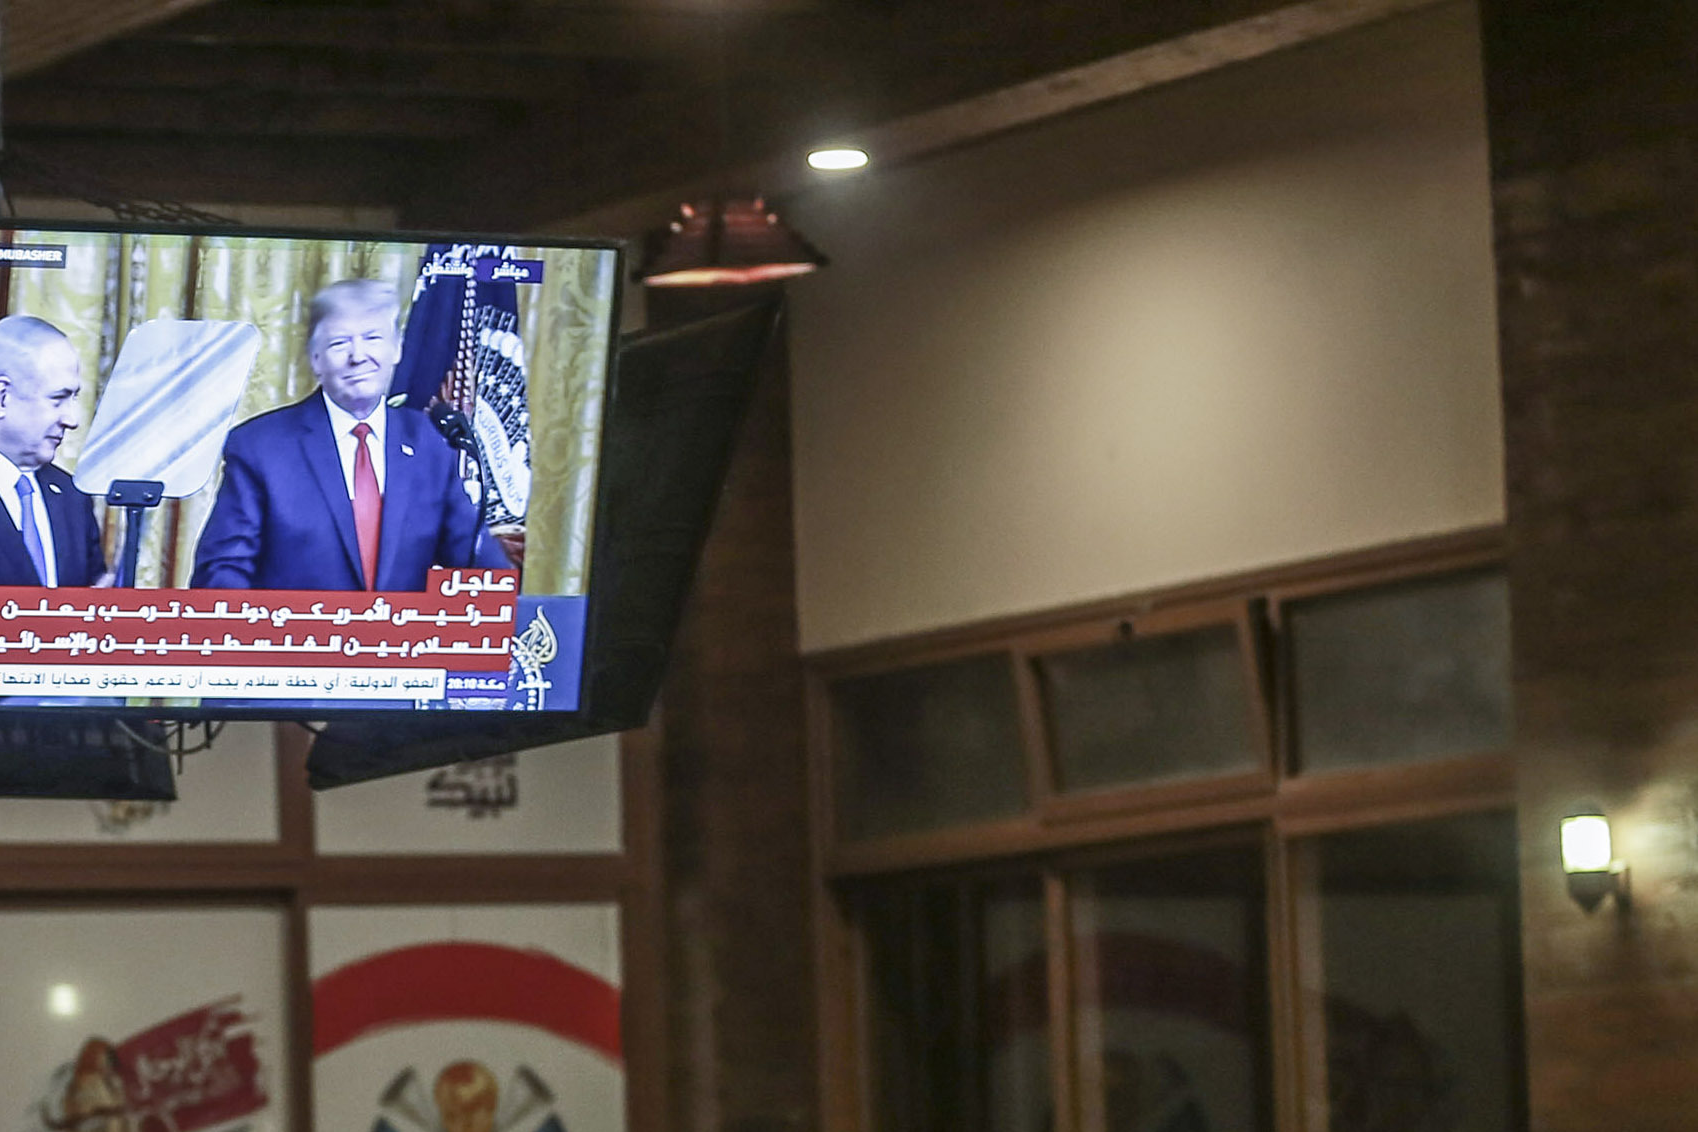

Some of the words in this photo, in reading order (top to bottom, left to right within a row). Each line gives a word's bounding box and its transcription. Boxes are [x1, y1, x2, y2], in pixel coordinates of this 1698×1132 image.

[491, 261, 530, 280] مباشر
[440, 569, 516, 597] عاجل
[0, 598, 97, 622] يعلن
[97, 599, 181, 622] ترمب
[181, 600, 270, 625] دونالد
[270, 597, 393, 628] الأمريكي
[392, 603, 513, 627] الرئيس
[98, 632, 342, 656] الفلسطينيين
[343, 636, 410, 658] بين
[410, 635, 510, 658] للسلام
[50, 672, 91, 687] ضحايا
[97, 673, 138, 689] حقوق
[143, 673, 181, 688] تدعم
[186, 674, 203, 690] أن
[207, 675, 240, 690] يجب
[244, 674, 280, 691] سلام
[285, 674, 317, 690] خطة
[403, 675, 440, 690] العفو
